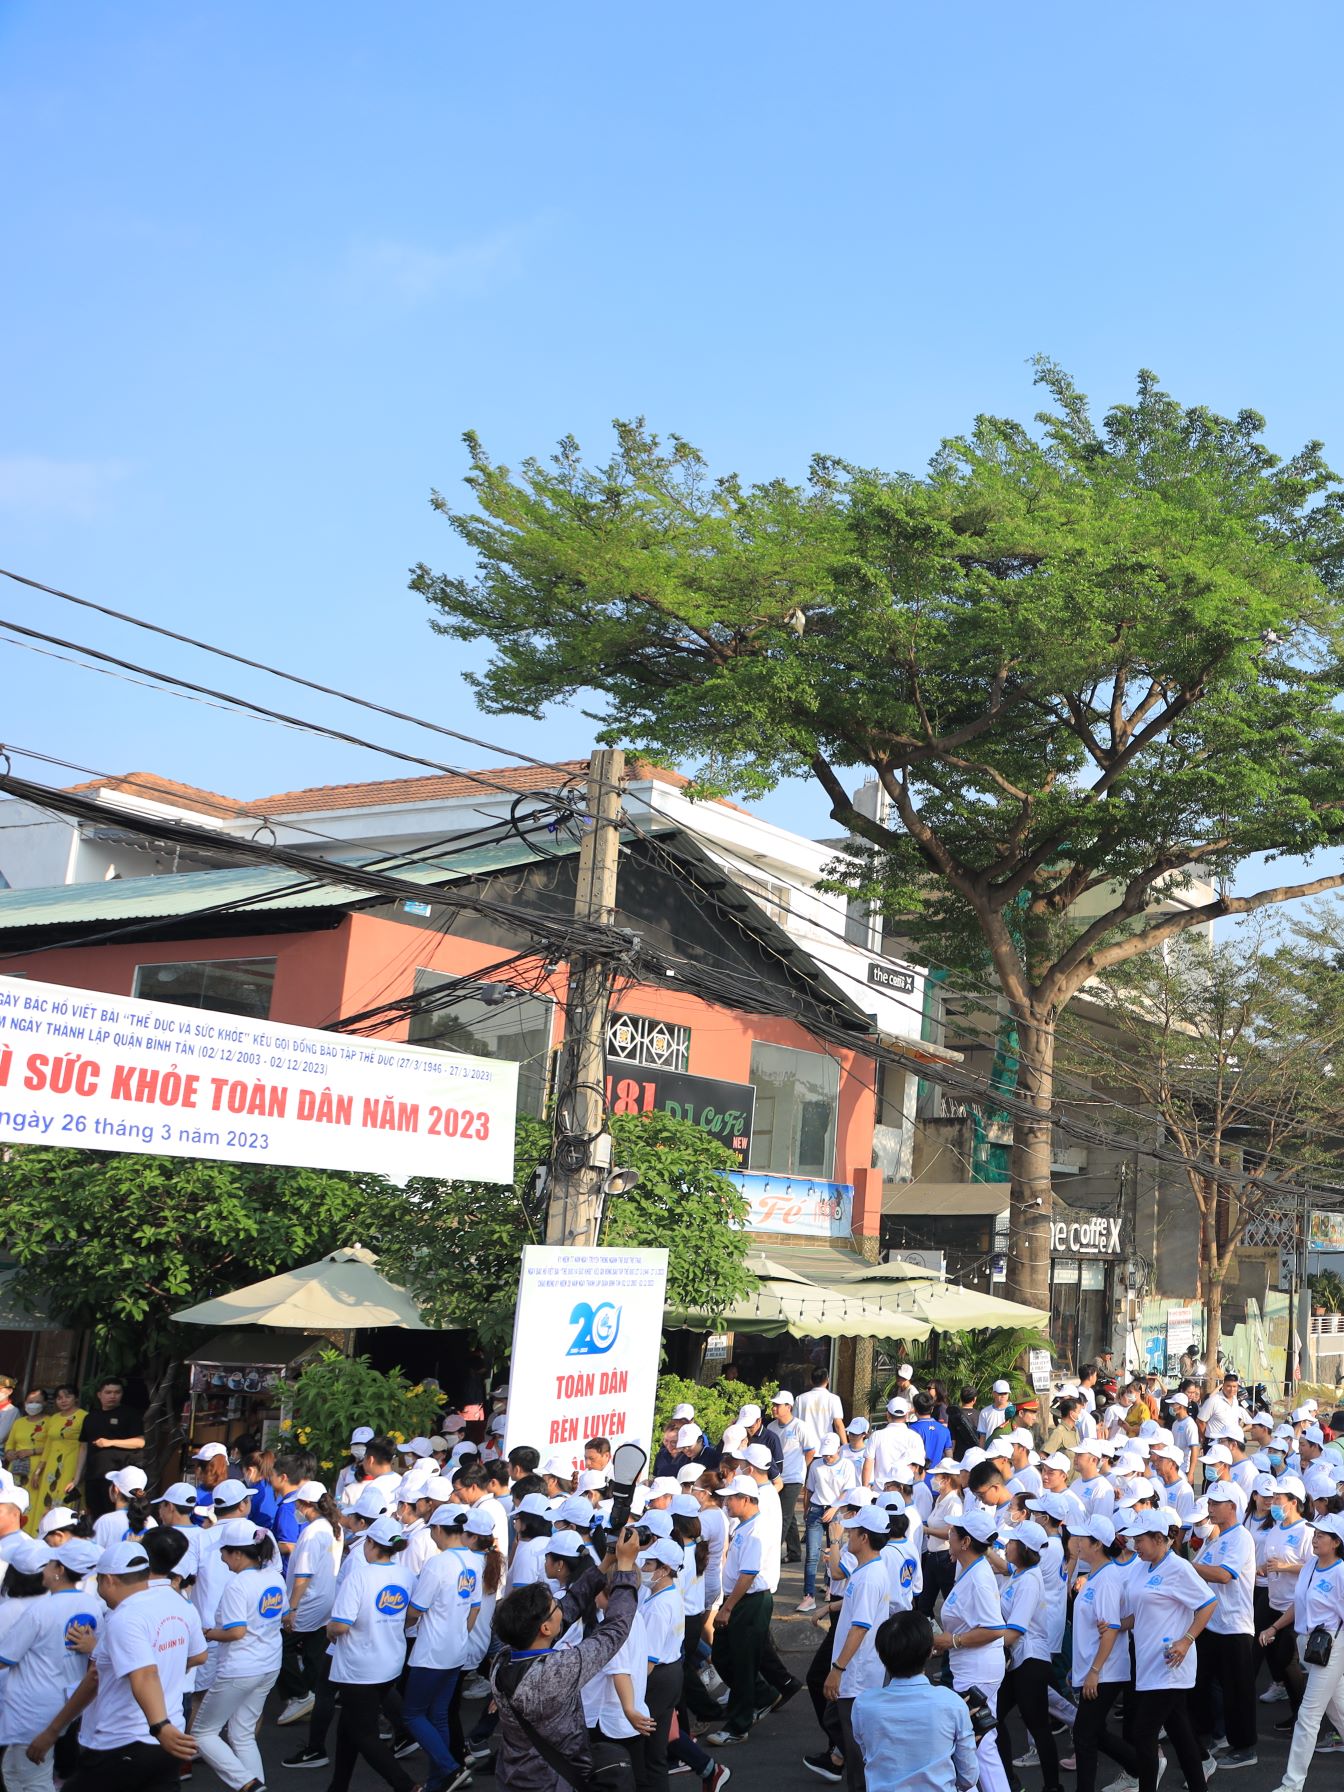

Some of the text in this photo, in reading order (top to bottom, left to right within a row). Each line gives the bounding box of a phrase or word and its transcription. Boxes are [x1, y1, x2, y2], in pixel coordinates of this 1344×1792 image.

[873, 967, 888, 984] the
[10, 1016, 42, 1034] NGÀY
[46, 1021, 85, 1041] THÀNH
[88, 1027, 110, 1046] LẬP
[113, 1032, 144, 1051] QUẬN
[146, 1035, 171, 1053] BÌNH
[175, 1041, 195, 1056] TÂN
[24, 995, 48, 1012] BÁC
[100, 1008, 119, 1024] BÀI
[179, 1020, 191, 1035] VÀ
[195, 1023, 215, 1039] SỨC
[253, 1032, 272, 1048] KÊU
[23, 1052, 101, 1098] SỨC
[110, 1063, 200, 1109] KHỎE
[211, 1077, 288, 1119] TOÀN
[296, 1086, 353, 1126] DÂN
[362, 1095, 419, 1133] NĂM
[427, 1106, 491, 1142] 2023
[0, 1109, 269, 1150] ngày 26 tháng 3 năm 2023
[732, 1136, 749, 1150] NEW
[556, 1367, 628, 1400] TOÀN DÂN
[549, 1408, 627, 1445] RÈN LUYỆN
